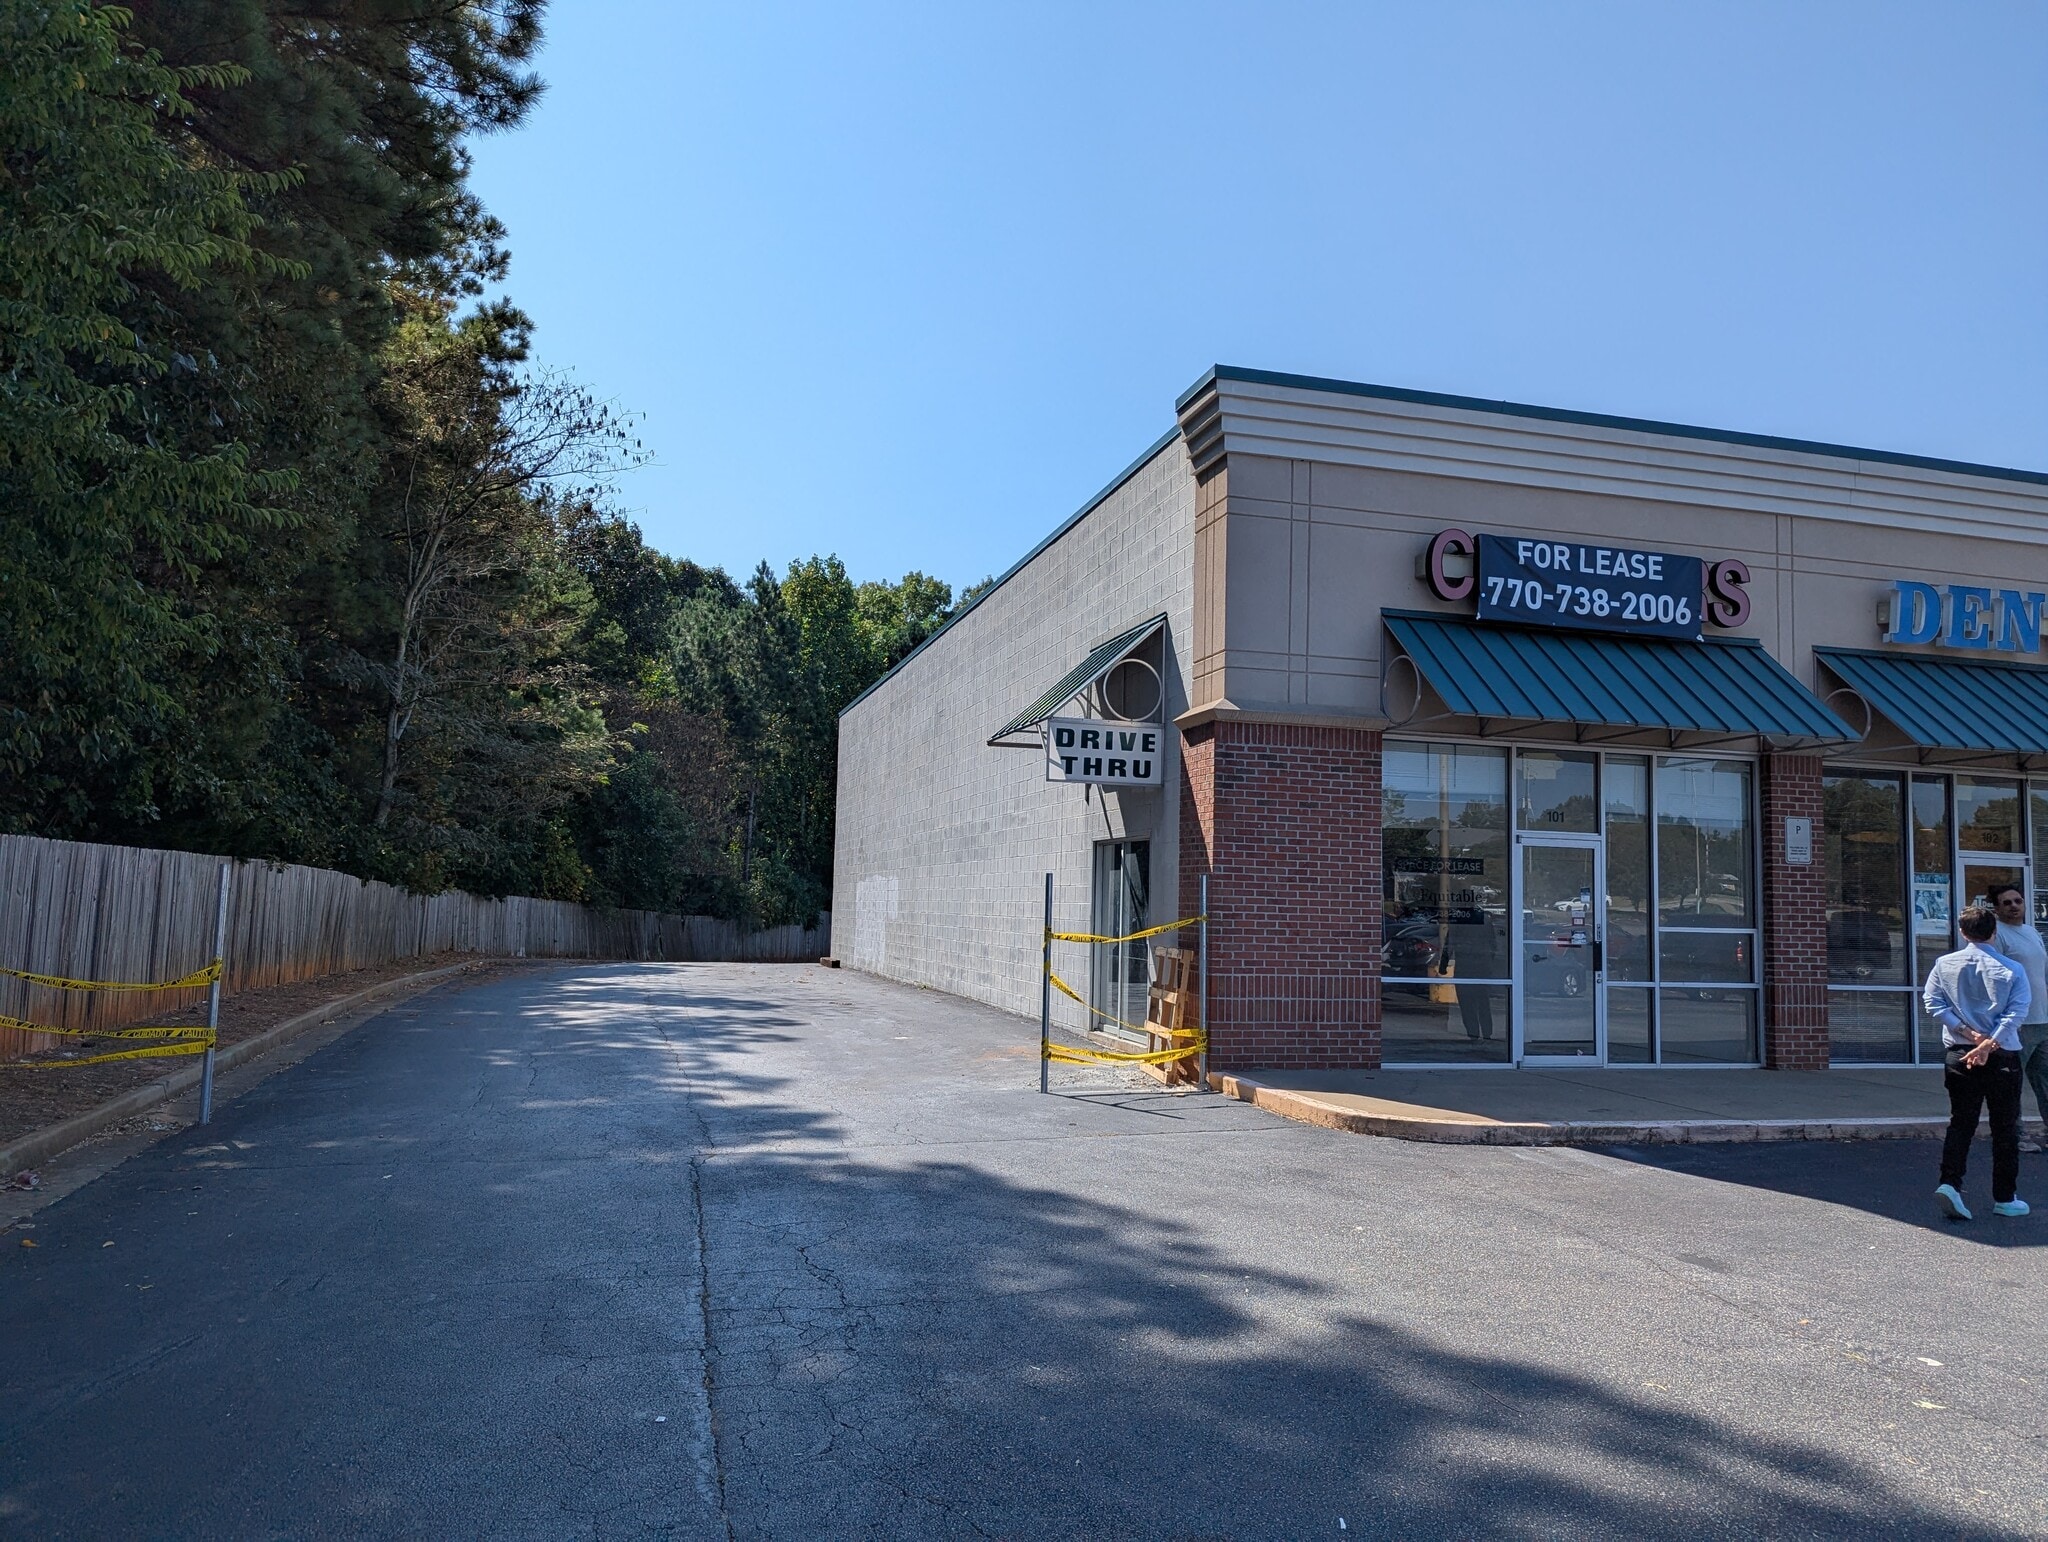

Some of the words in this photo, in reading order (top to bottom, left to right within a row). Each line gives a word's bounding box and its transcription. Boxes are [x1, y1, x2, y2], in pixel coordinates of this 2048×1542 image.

[1518, 541, 1570, 571] FOR
[1579, 548, 1663, 580] LEASE
[1487, 576, 1692, 625] 770-738-2006
[1889, 580, 2048, 654] DEN
[1056, 728, 1155, 752] DRIVE
[1061, 756, 1151, 778] THRU
[1546, 811, 1565, 823] 101
[1453, 862, 1481, 872] LEASE
[1421, 889, 1483, 905] Equitable
[182, 1029, 215, 1038] CAUTION
